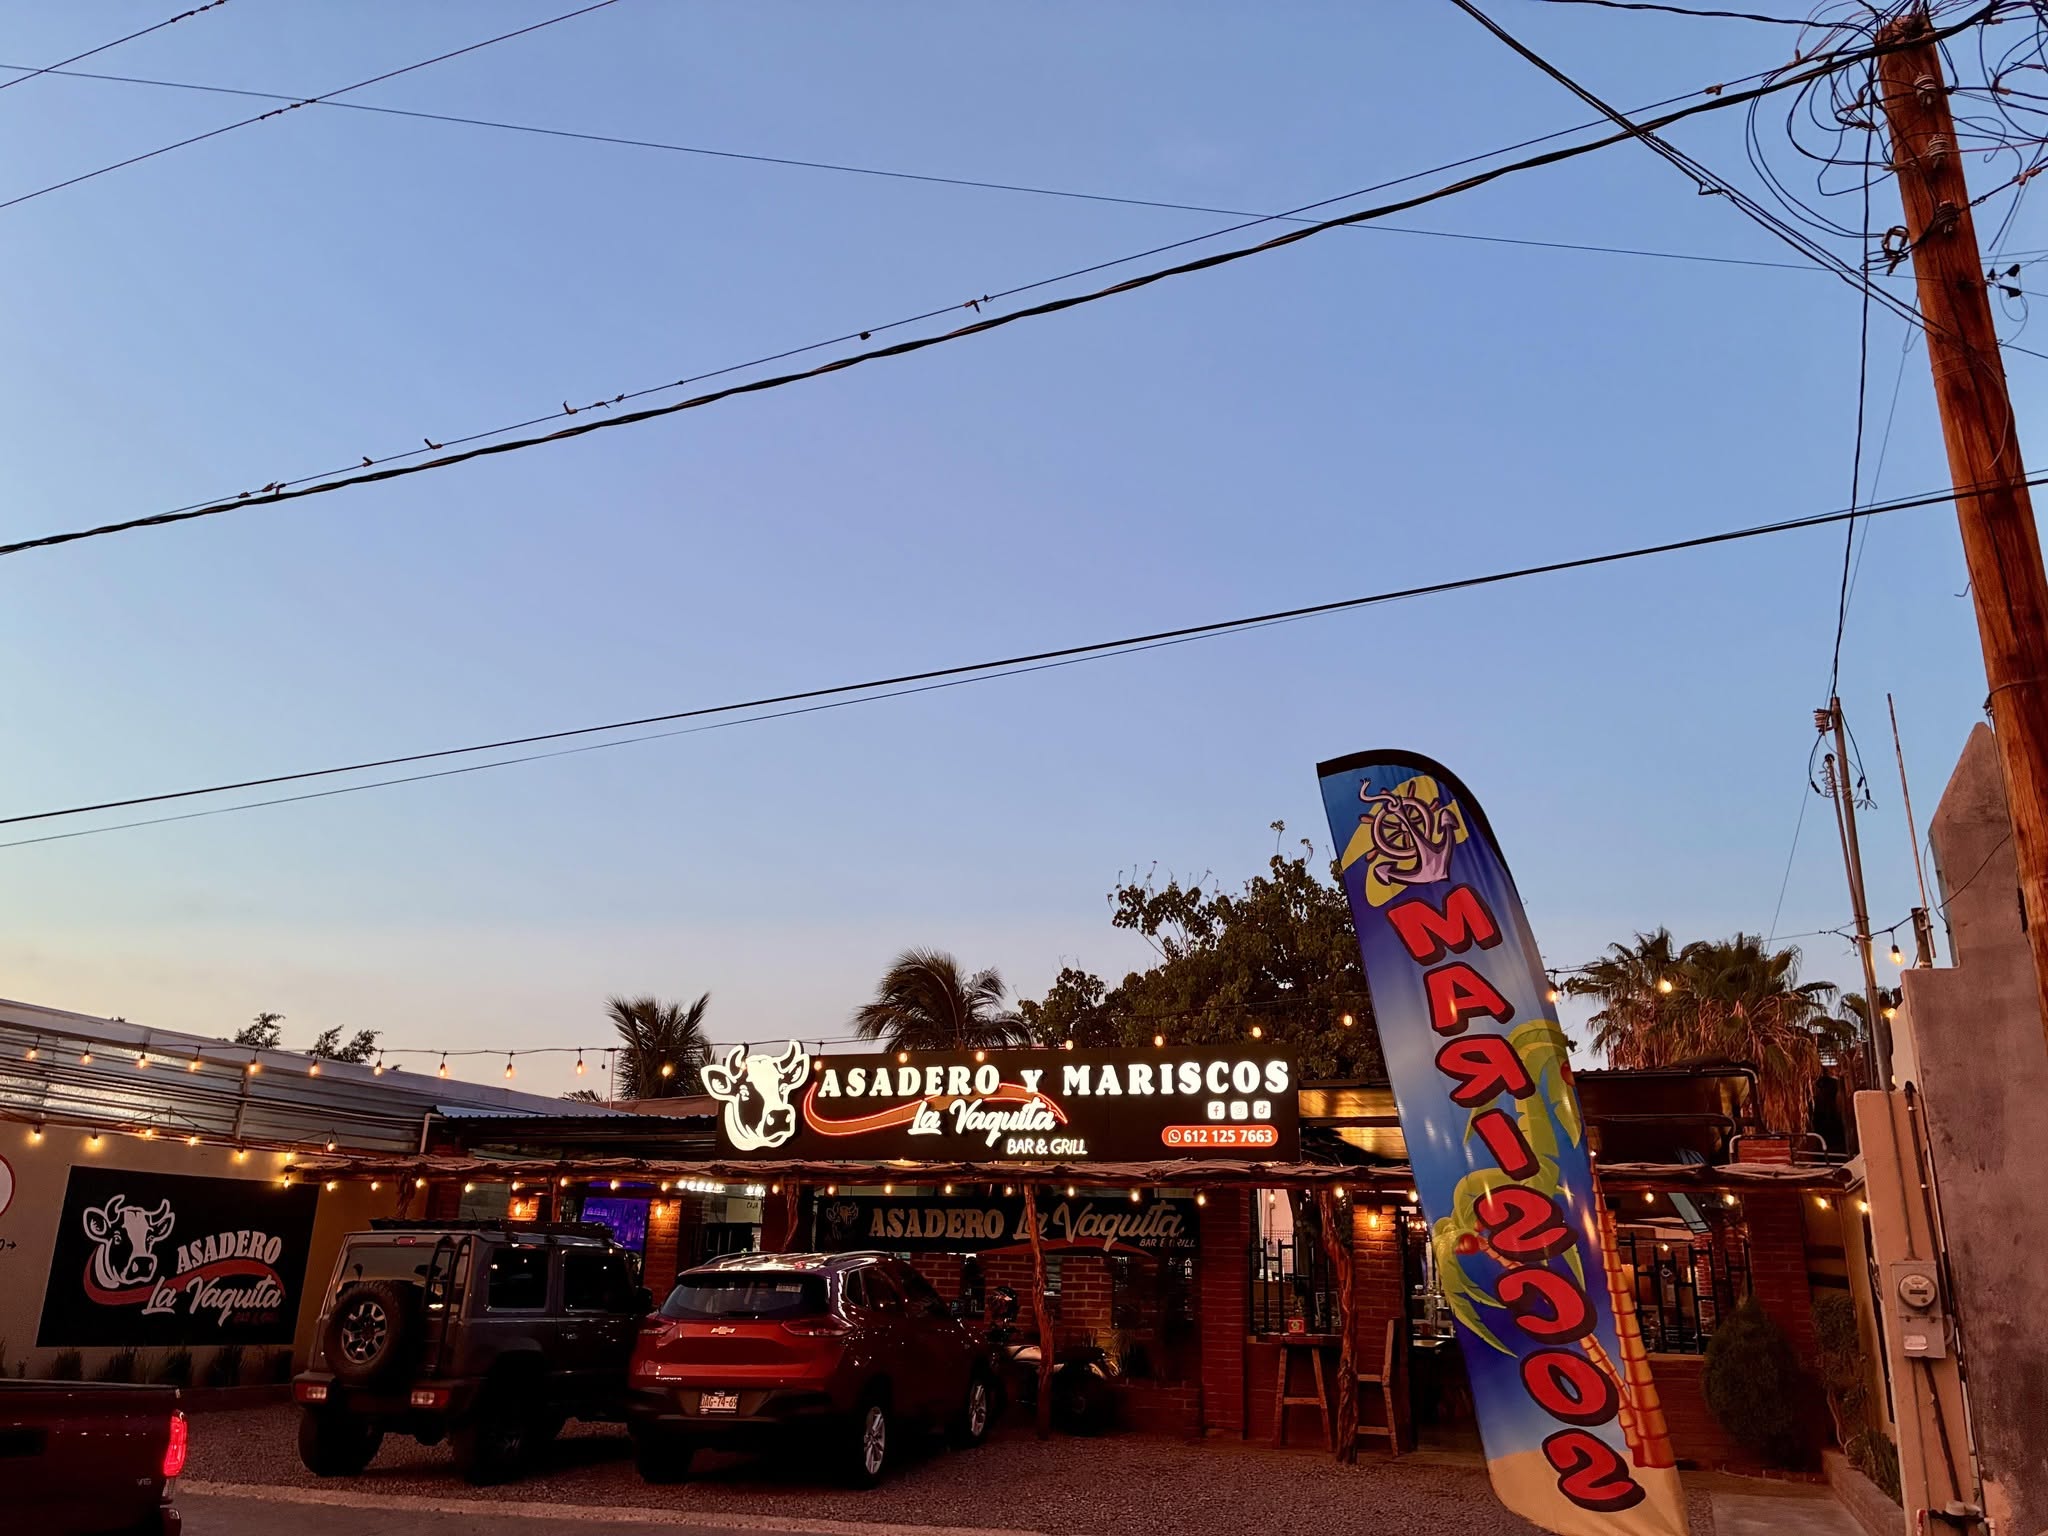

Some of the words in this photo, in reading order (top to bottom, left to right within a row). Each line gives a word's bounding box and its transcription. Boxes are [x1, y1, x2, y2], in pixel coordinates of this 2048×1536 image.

[817, 1064, 1000, 1098] ASADERO
[1020, 1069, 1044, 1093] Y
[1062, 1060, 1289, 1096] MARISCOS
[907, 1100, 942, 1135] La
[949, 1096, 1056, 1147] Vaquita
[1183, 1129, 1207, 1143] 612
[1211, 1129, 1235, 1143] 125
[1239, 1129, 1273, 1143] 7663
[1006, 1138, 1034, 1155] BAR
[1035, 1138, 1049, 1155] &
[1050, 1138, 1088, 1155] GRILL
[869, 1208, 1005, 1239] ASADERO
[1053, 1200, 1185, 1253] Vaquita
[1139, 1238, 1157, 1247] BAR
[176, 1230, 282, 1275] ASADERO
[141, 1275, 177, 1315] La
[185, 1274, 282, 1327] Vaquita
